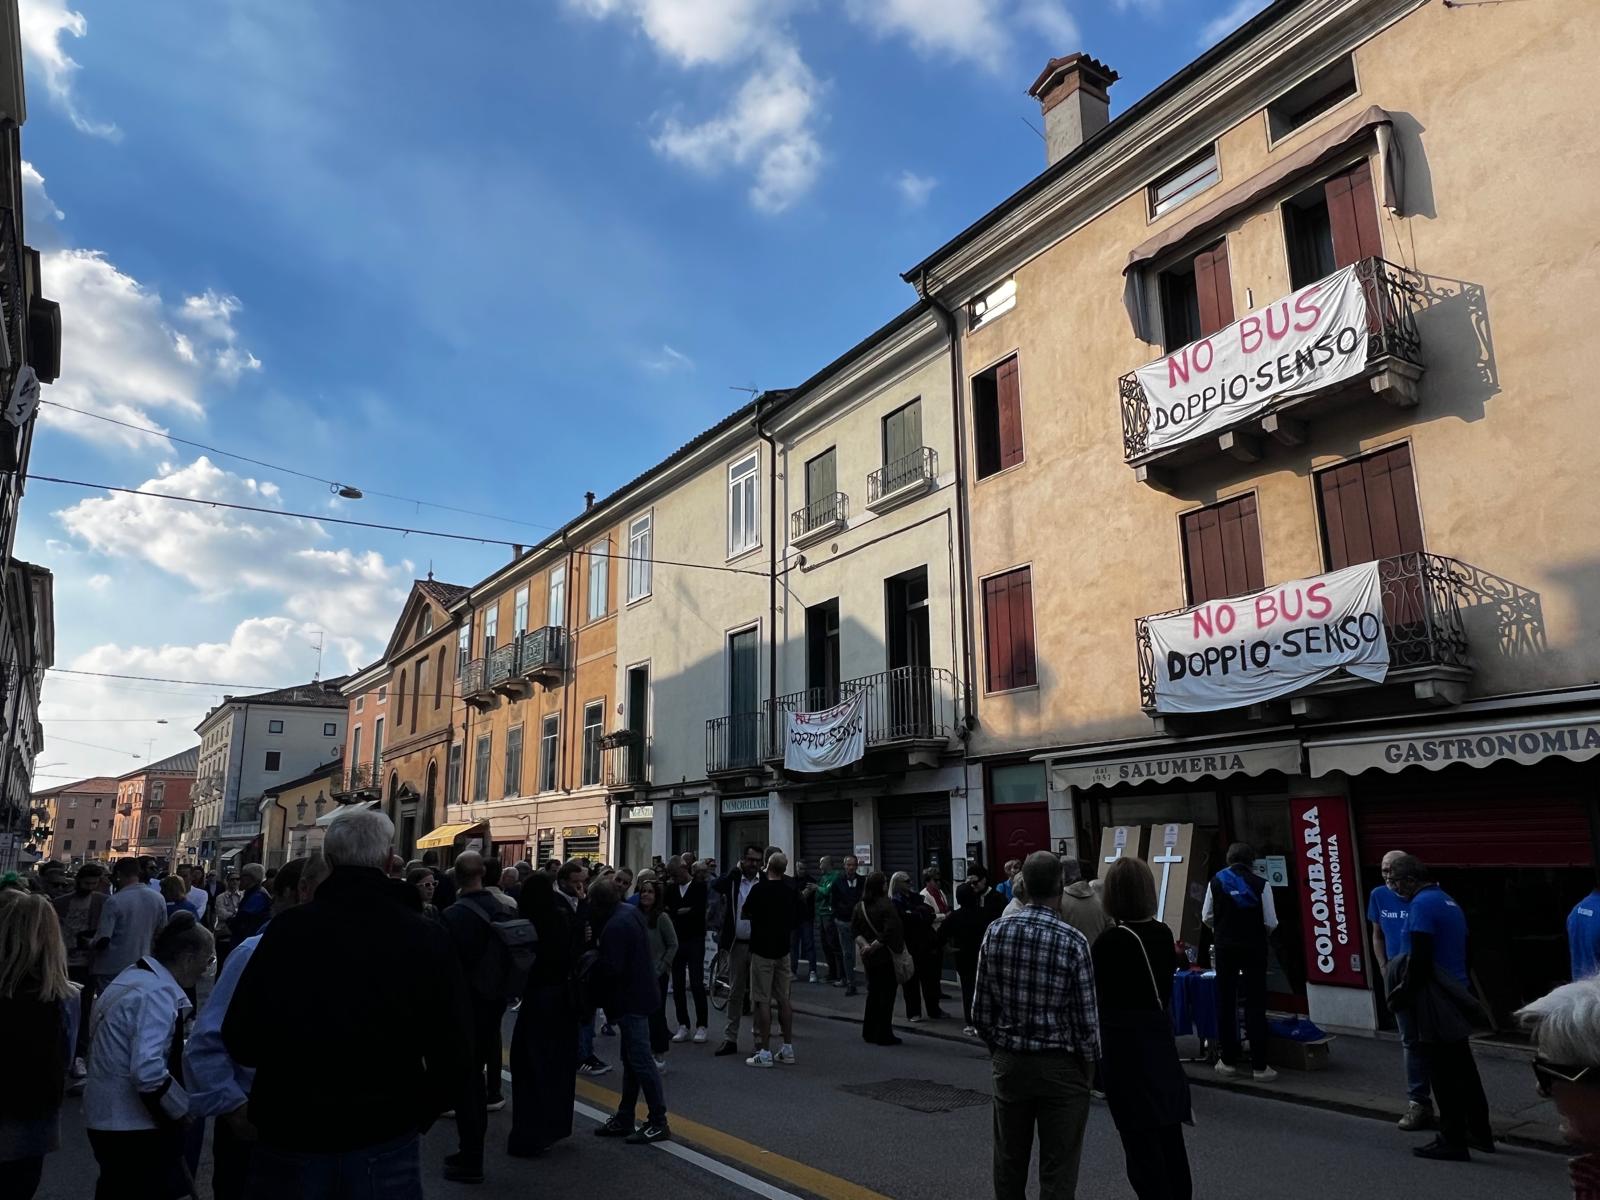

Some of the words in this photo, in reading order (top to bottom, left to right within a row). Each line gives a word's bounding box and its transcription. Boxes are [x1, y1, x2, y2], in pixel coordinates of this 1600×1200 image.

[1168, 340, 1213, 388] NO
[1239, 286, 1321, 353] BUS
[1193, 605, 1236, 639] NO
[1255, 583, 1332, 629] BUS
[1120, 754, 1245, 779] SALUMERIA
[1385, 727, 1600, 763] GASTRONOMIA
[1302, 806, 1335, 973] COLOMBARA
[1328, 834, 1348, 944] GASTRONOMIA
[1381, 909, 1398, 919] San
